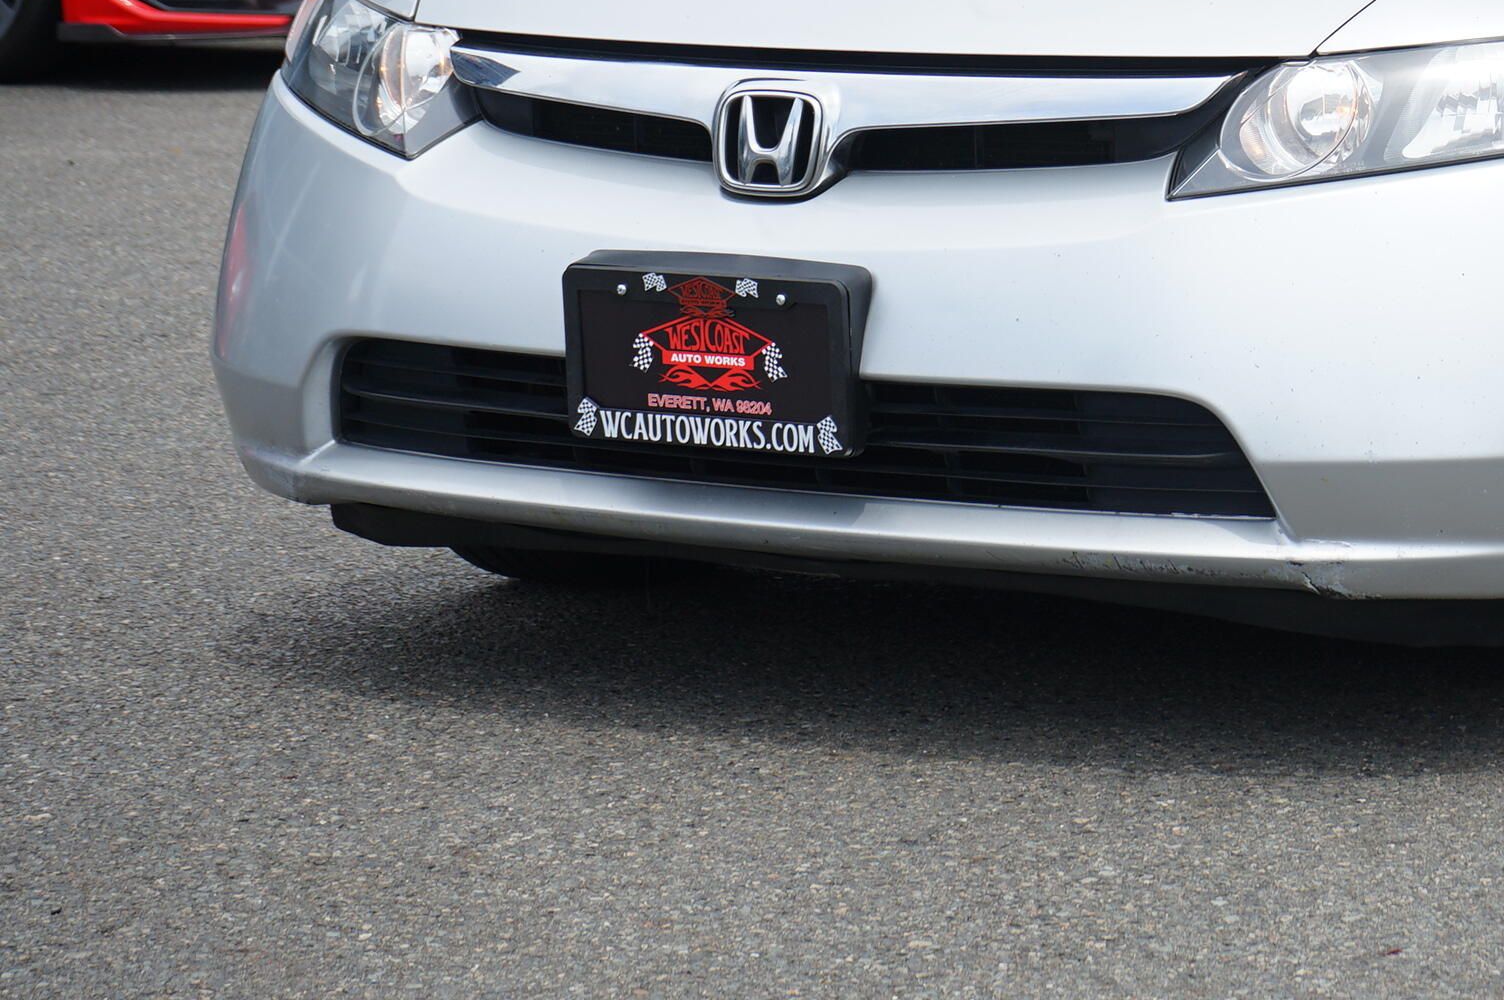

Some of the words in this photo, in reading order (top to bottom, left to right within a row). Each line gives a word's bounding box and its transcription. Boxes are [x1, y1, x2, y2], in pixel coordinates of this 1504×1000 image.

[670, 353, 703, 364] AUTO
[704, 356, 746, 367] WORKS
[647, 393, 711, 412] EVERETT,
[711, 397, 735, 413] WA
[600, 410, 815, 453] WCAUTOWORKS.COM
